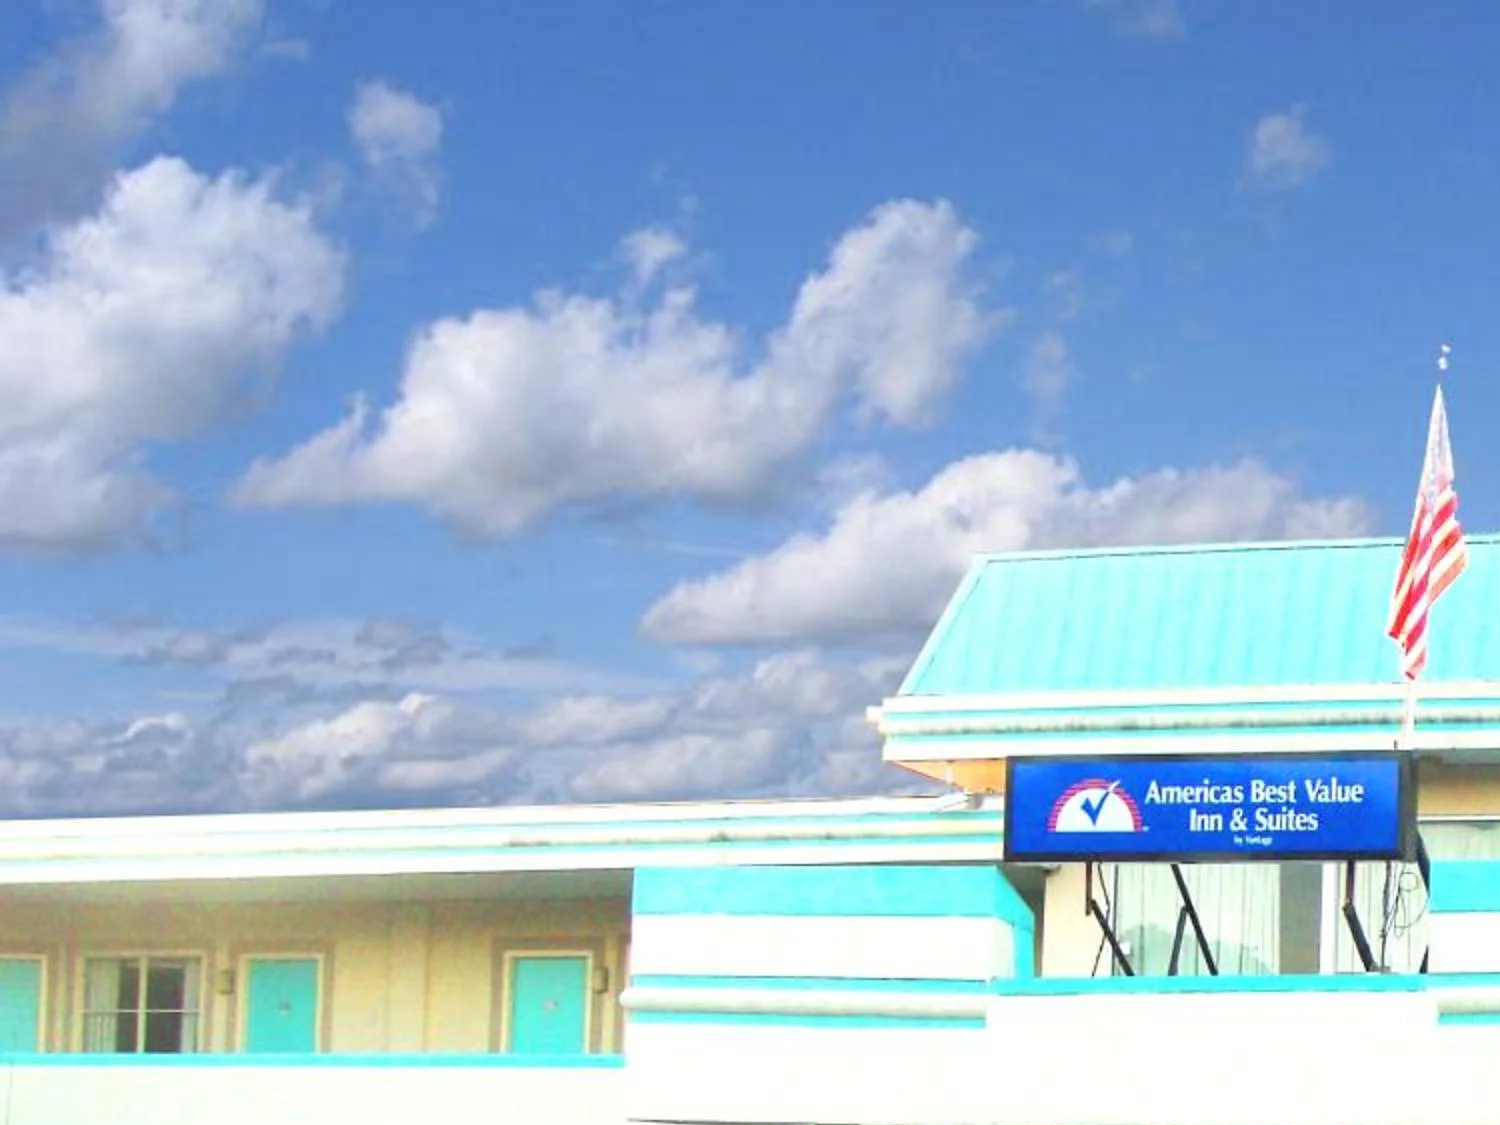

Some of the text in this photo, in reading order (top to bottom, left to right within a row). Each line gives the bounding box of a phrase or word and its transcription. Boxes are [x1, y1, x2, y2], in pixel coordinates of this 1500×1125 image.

[1144, 776, 1364, 804] Americas Best Value
[1189, 805, 1319, 832] Inn & Suites
